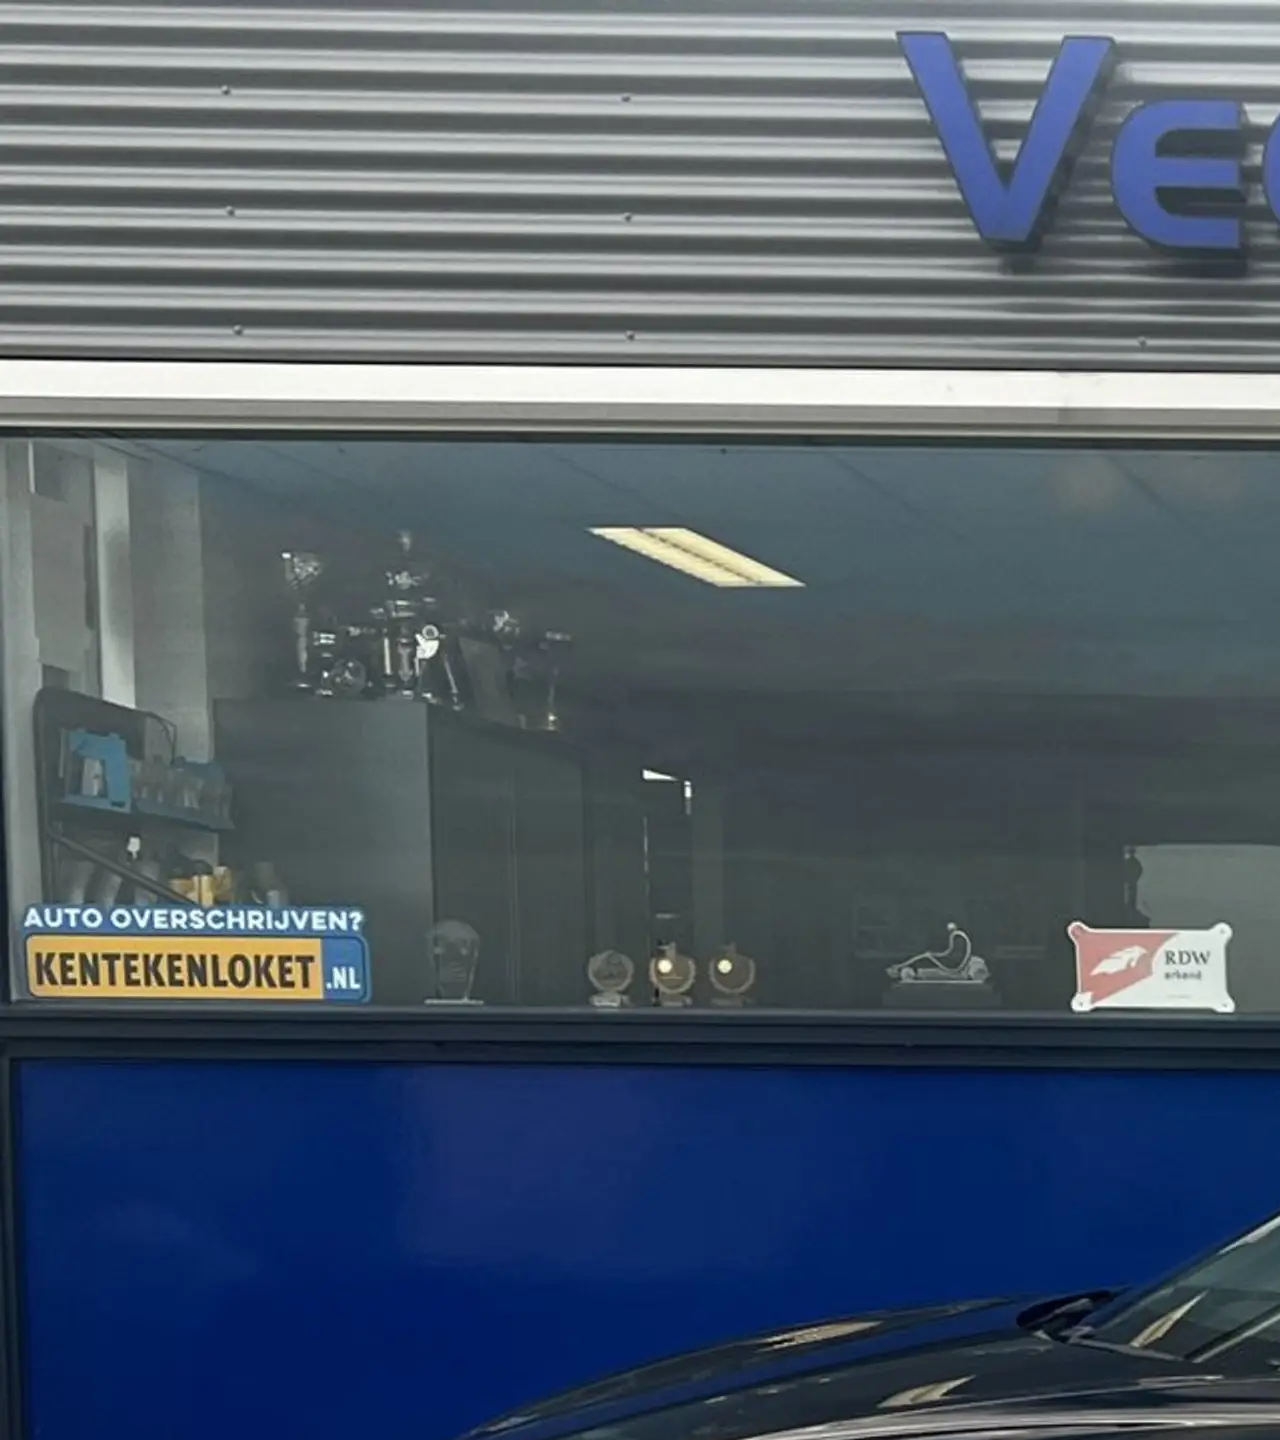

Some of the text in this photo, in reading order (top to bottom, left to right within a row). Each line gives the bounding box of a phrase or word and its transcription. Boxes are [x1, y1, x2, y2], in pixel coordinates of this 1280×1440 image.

[24, 907, 363, 931] AUTO OVERSCHRIJVEN?
[1164, 950, 1211, 966] RDW
